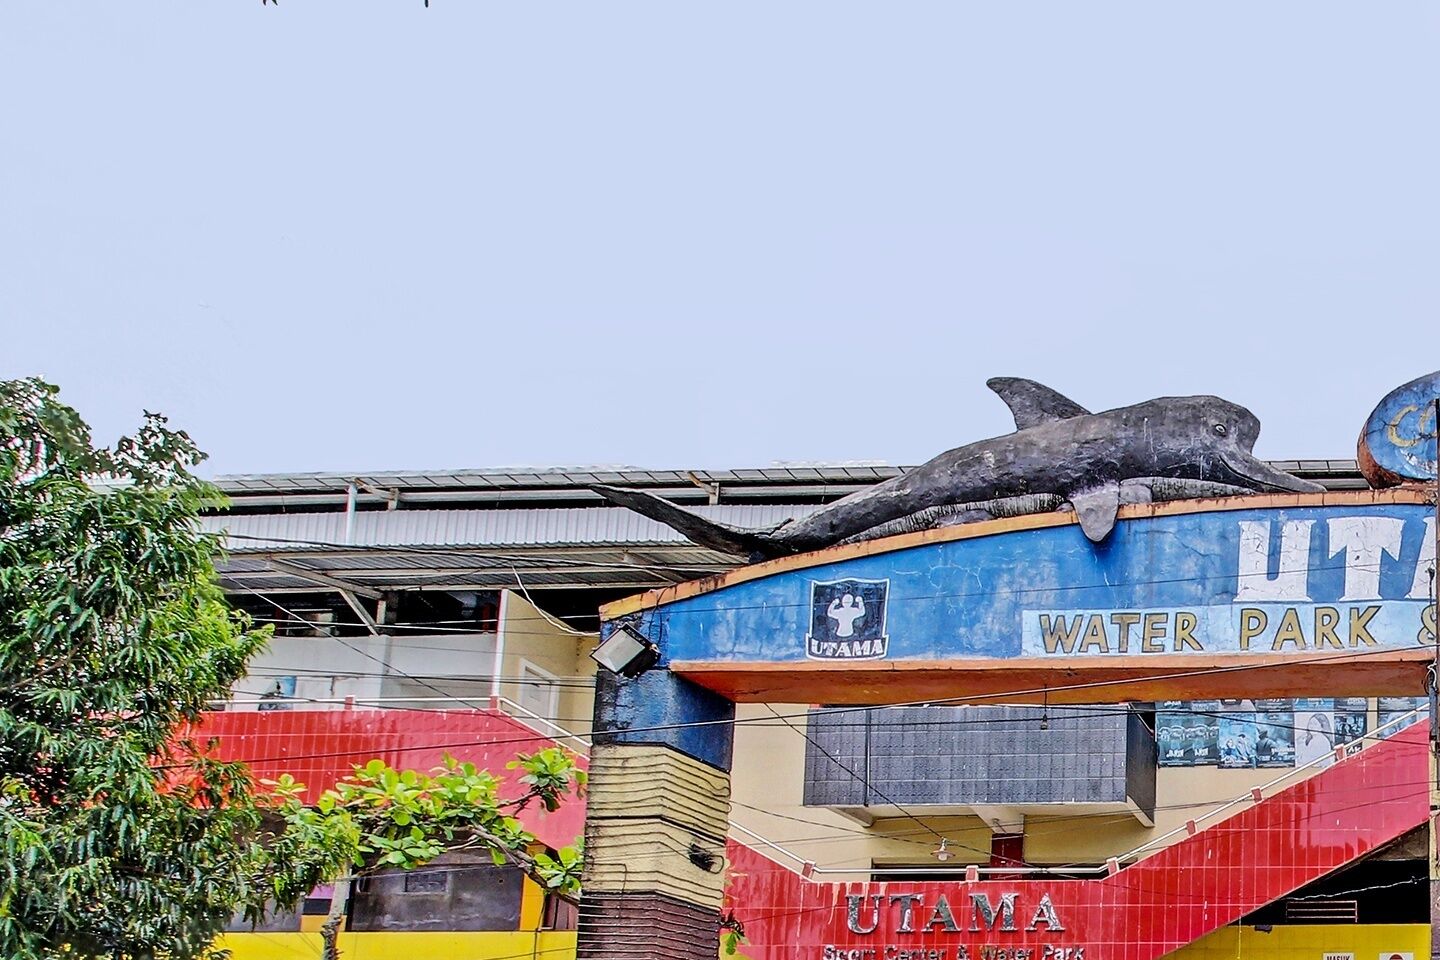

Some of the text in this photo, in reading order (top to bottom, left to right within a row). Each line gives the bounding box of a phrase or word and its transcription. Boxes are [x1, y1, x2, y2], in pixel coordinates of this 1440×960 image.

[810, 638, 885, 658] UTAMA
[1038, 611, 1205, 654] WATER
[1239, 604, 1384, 651] PARK
[845, 891, 1066, 935] UTAMA
